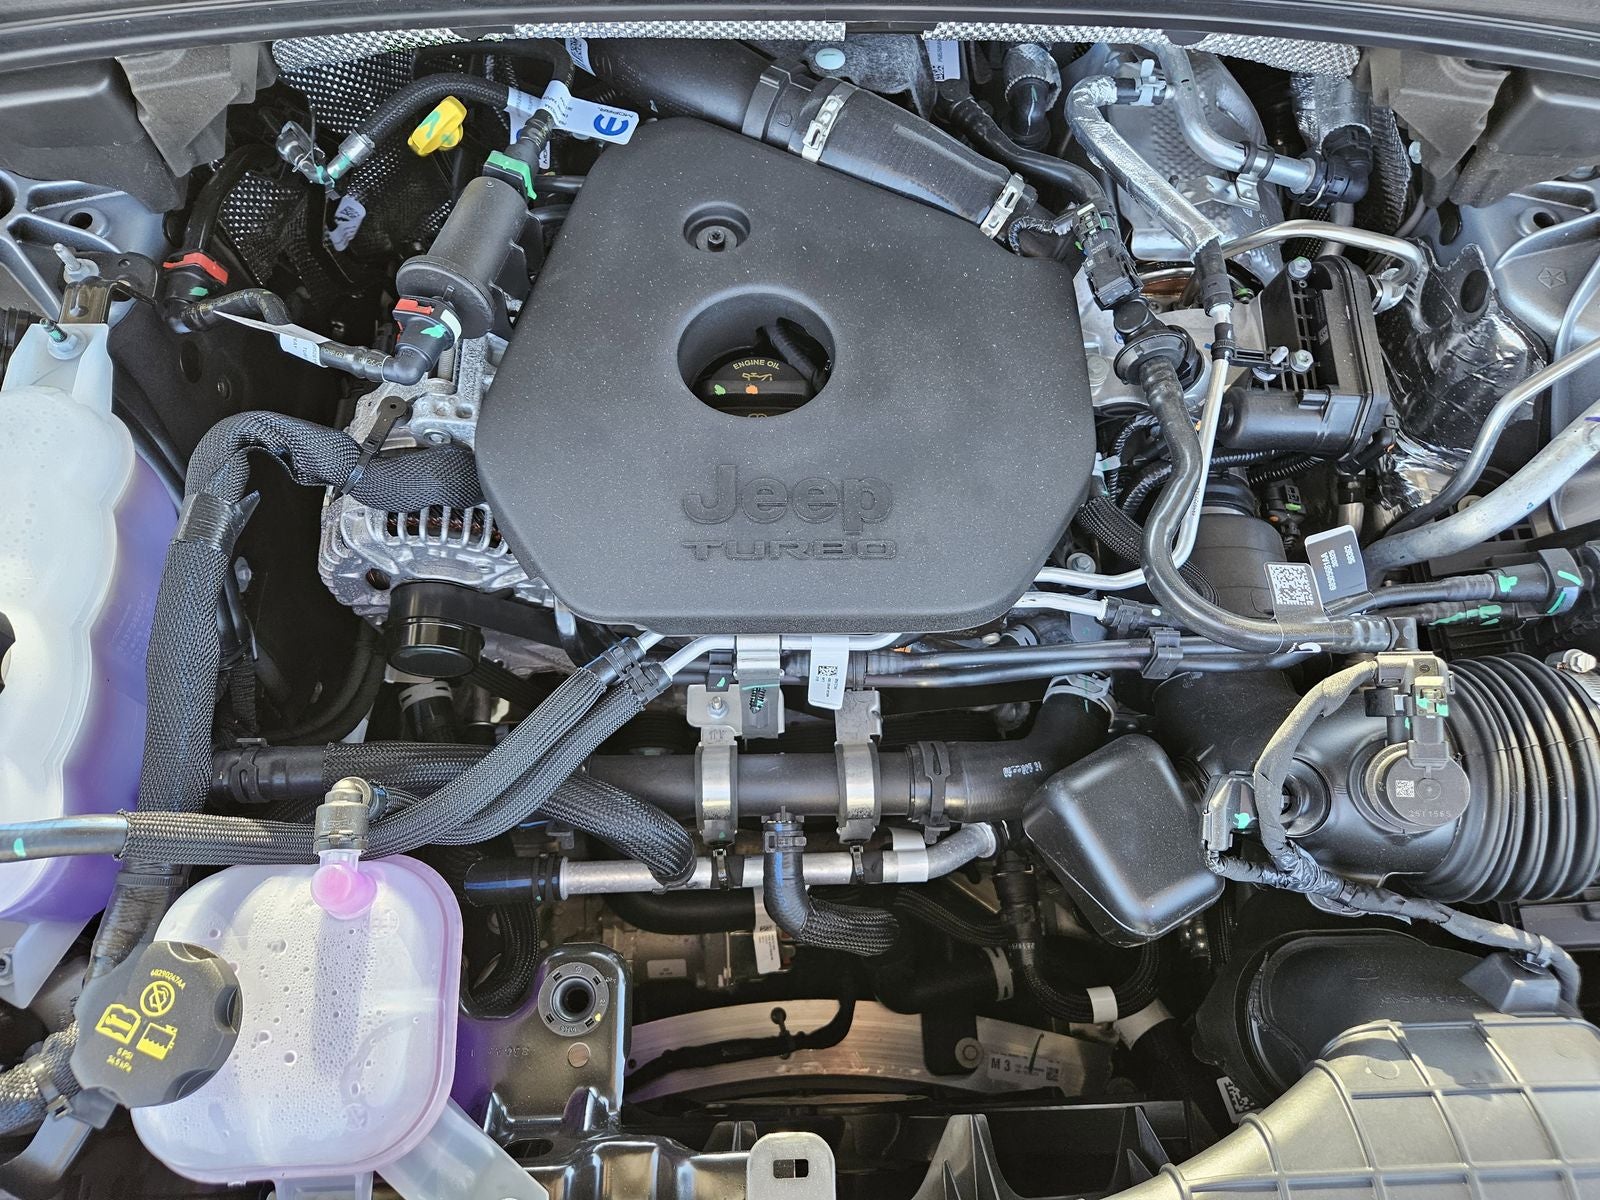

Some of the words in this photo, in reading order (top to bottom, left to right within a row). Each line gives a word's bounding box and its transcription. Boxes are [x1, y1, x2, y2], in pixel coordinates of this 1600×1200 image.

[732, 359, 765, 370] ENGINE
[767, 360, 781, 370] OIL
[682, 464, 893, 535] Jeep
[681, 540, 897, 561] TURBO
[991, 1058, 1000, 1070] M
[1004, 1060, 1011, 1072] 3
